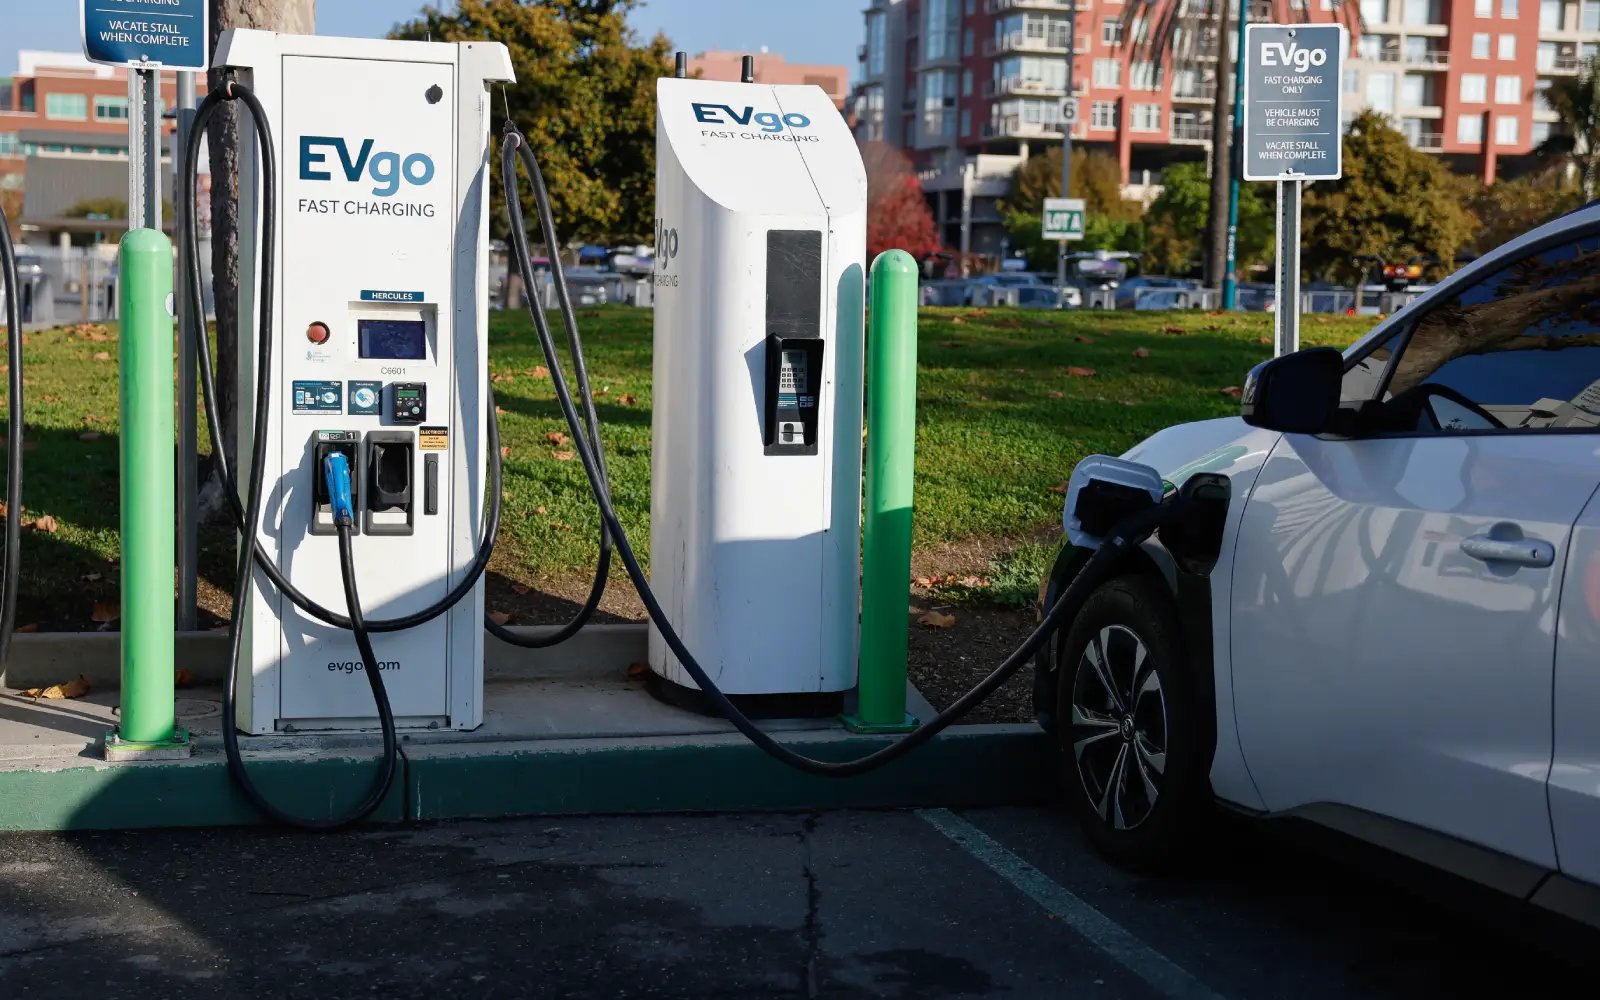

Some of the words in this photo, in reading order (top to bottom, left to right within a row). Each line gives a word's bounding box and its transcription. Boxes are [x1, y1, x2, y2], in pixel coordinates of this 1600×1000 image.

[109, 20, 148, 32] VACATE
[150, 23, 180, 34] STALL
[100, 31, 132, 42] WHEN
[134, 34, 189, 46] COMPLETE
[1260, 42, 1327, 73] EVgo
[1264, 75, 1282, 84] FAST
[1282, 75, 1323, 84] CHARGING
[1282, 85, 1304, 94] ONLY
[691, 102, 811, 133] EVgo
[1063, 102, 1075, 119] 6
[1264, 108, 1297, 117] VEHICLE
[1298, 108, 1321, 117] MUST
[1266, 118, 1276, 127] BE
[1277, 118, 1320, 127] CHARGING
[701, 130, 736, 139] FAST
[740, 132, 819, 143] CHARGING
[1265, 141, 1295, 150] VACATE
[1296, 141, 1319, 150] STALL
[1258, 151, 1283, 160] WHEN
[1284, 150, 1327, 160] COMPLETE
[299, 135, 435, 197] EVgo
[298, 199, 340, 214] FAST
[344, 200, 435, 218] CHARGING
[1046, 212, 1071, 230] LOT
[1071, 212, 1082, 230] A
[655, 217, 679, 270] Vgo
[371, 291, 413, 301] HERCULES
[380, 366, 406, 375] C6601
[327, 660, 401, 674] evgoom
